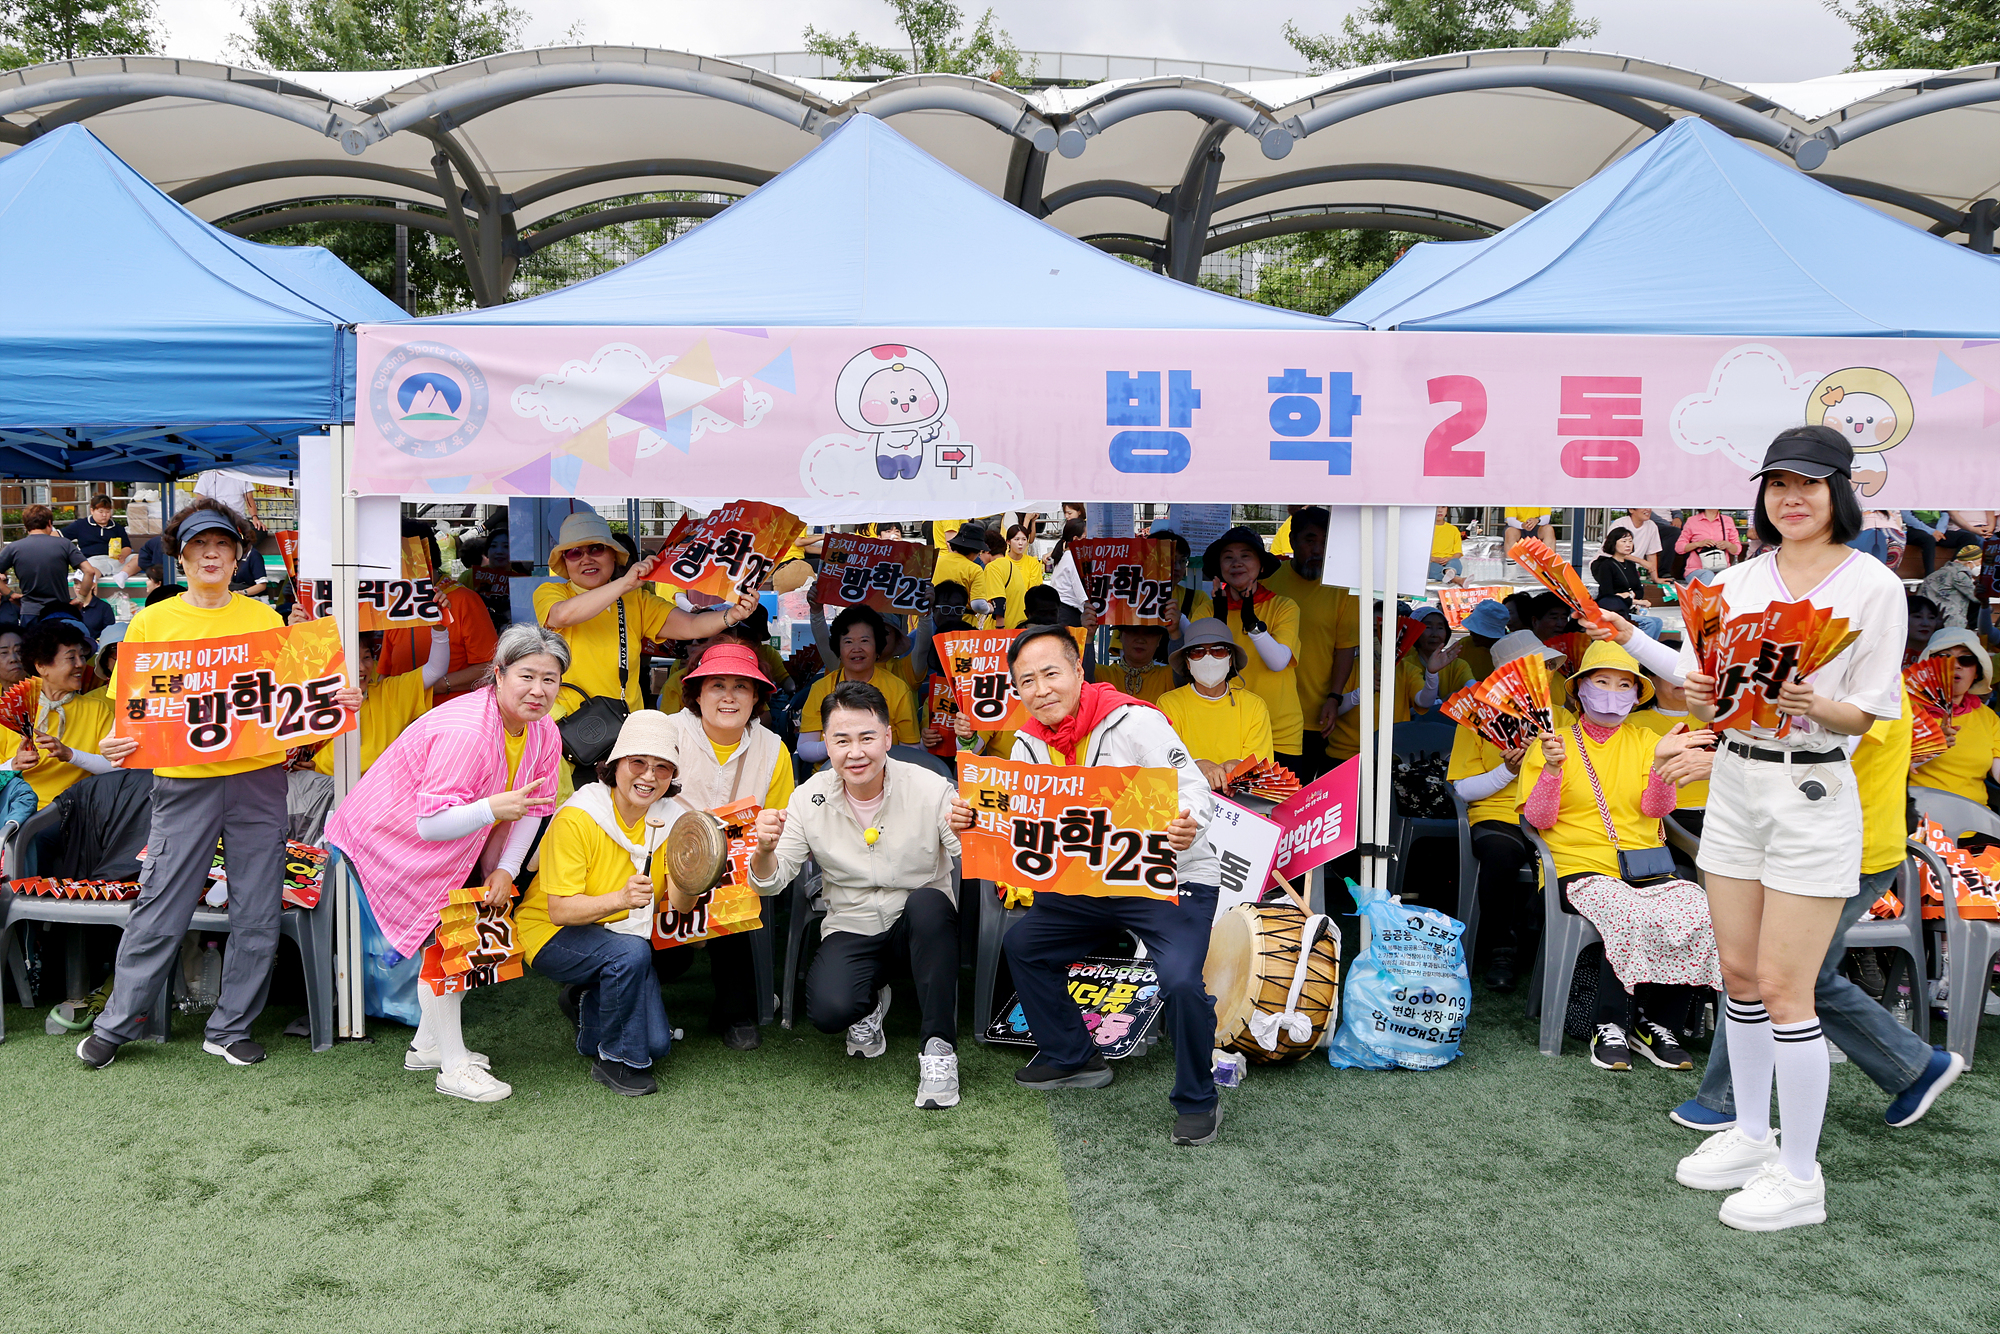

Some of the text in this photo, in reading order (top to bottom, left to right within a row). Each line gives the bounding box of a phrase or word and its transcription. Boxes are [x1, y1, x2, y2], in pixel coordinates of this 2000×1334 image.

[374, 345, 485, 390] Dobong Sports Council
[380, 420, 478, 455] 도봉구 체육회
[858, 543, 893, 557] 이기자!
[1095, 544, 1129, 559] 이기자!
[617, 597, 625, 624] PARIS
[134, 644, 249, 672] 즐기자! 이기자!
[984, 637, 1012, 653] 이기
[149, 670, 217, 694] 도봉에서
[126, 669, 346, 752] 짱되는 방학2동
[963, 764, 1085, 797] 즐기자! 이기자!
[979, 789, 1045, 818] 도봉에서
[1225, 811, 1240, 827] 도봉
[1277, 802, 1343, 869] 방학2동
[1010, 806, 1178, 896] 방학2동
[1428, 926, 1458, 944] 도봉구
[1395, 987, 1466, 1010] dobong
